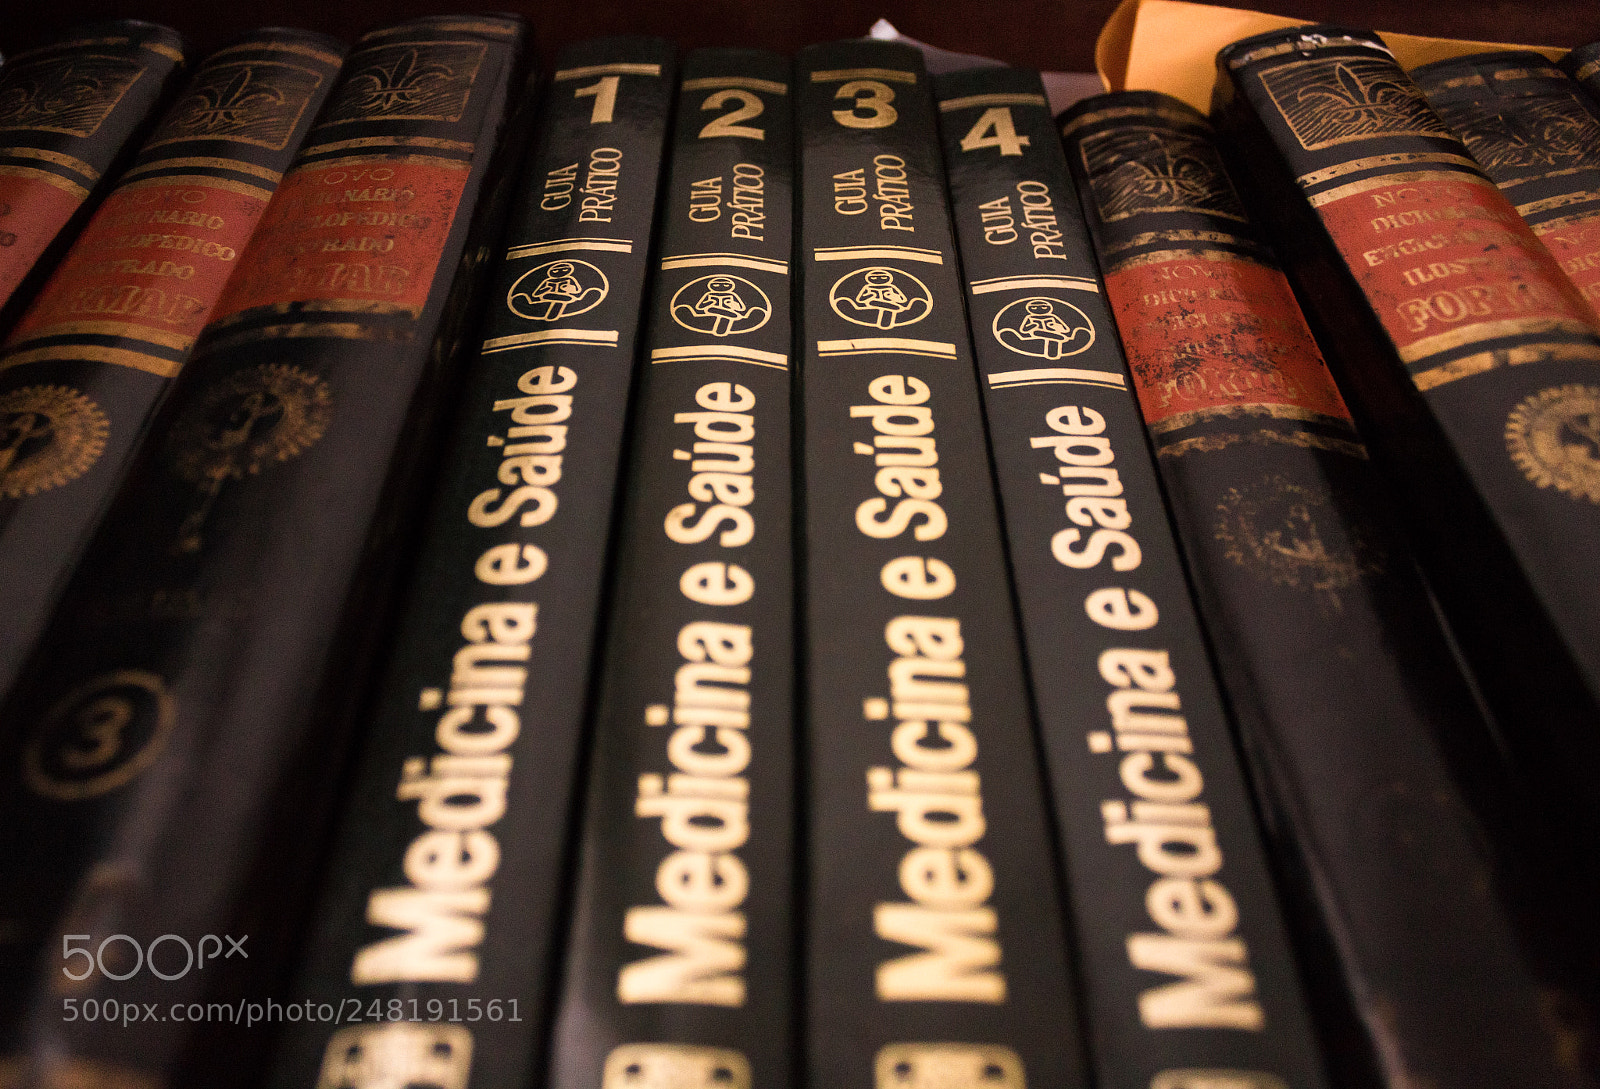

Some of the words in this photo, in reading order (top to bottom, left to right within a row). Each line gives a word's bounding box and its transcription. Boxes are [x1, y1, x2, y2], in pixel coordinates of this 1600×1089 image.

[575, 76, 620, 124] 1
[699, 90, 765, 140] 2
[832, 80, 898, 129] 3
[960, 107, 1031, 156] 4
[540, 162, 579, 211] GUIA
[578, 147, 623, 223] PRÁTICO
[688, 176, 723, 223] GUIA
[726, 162, 766, 242] PRÁTICO
[833, 168, 869, 216] GUIA
[872, 154, 915, 232] PRÁTICO
[978, 196, 1019, 245] GUIA
[1016, 180, 1067, 260] PRÁTICO
[467, 364, 579, 528] Saúde
[663, 380, 757, 548] Saúde
[848, 373, 949, 542] Saúde
[1029, 403, 1143, 573] Saúde
[474, 542, 549, 586] e
[679, 561, 755, 607] e
[880, 555, 957, 601] e
[1085, 587, 1160, 631] e
[61, 696, 134, 769] 3
[352, 601, 538, 984] Medicina
[617, 620, 754, 1007] Medicina
[861, 614, 1007, 1003] Medicina
[1087, 647, 1266, 1031] Medicina
